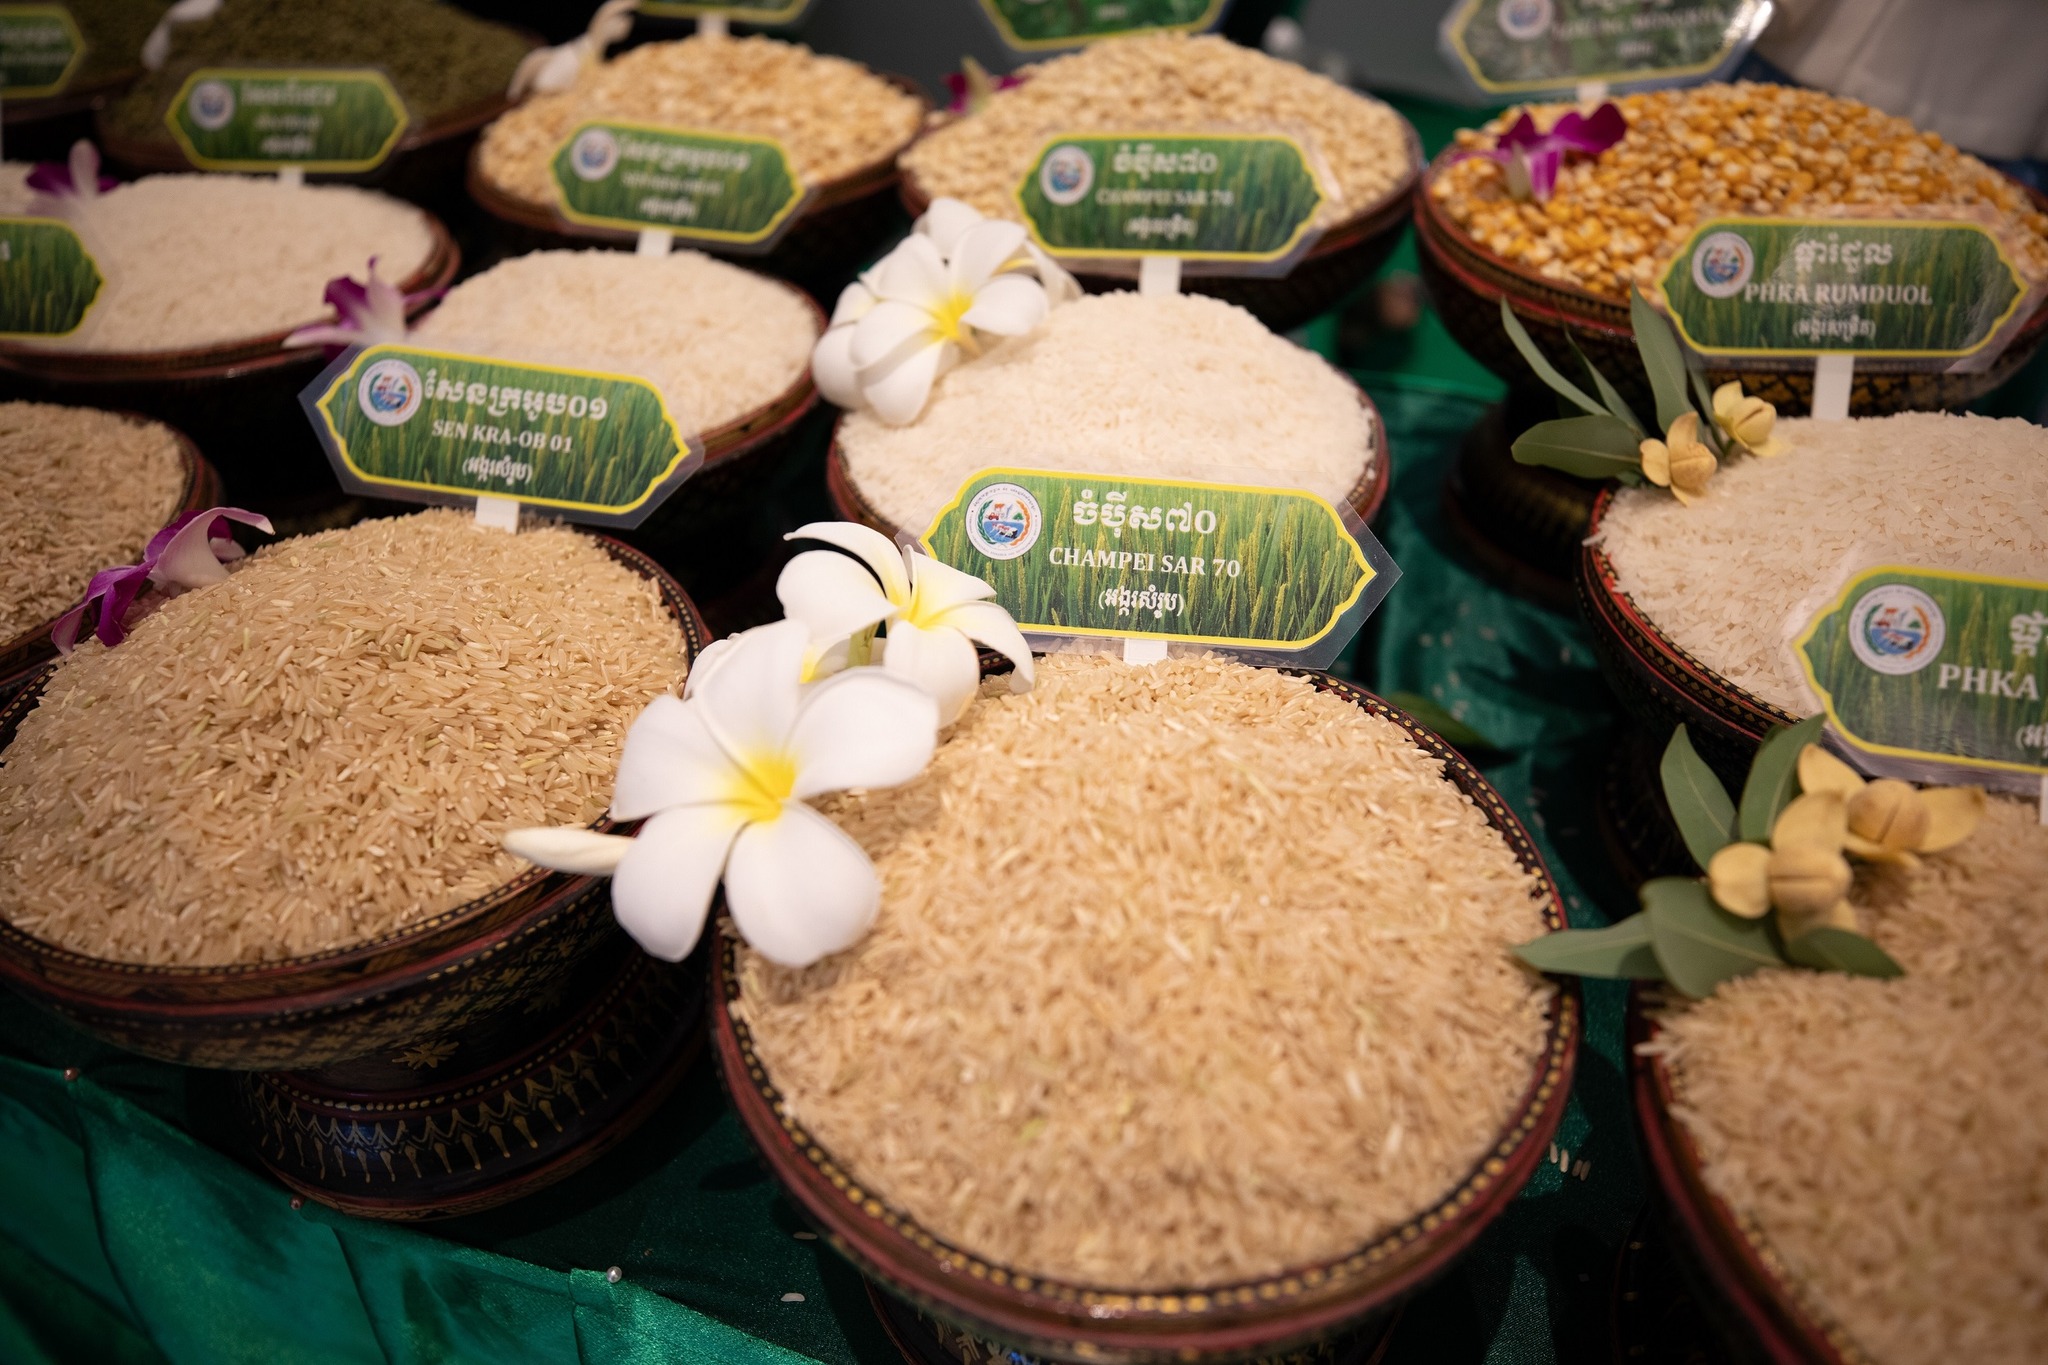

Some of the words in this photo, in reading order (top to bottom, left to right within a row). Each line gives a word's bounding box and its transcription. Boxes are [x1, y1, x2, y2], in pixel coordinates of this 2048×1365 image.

[1743, 283, 1809, 304] PHKA
[1815, 283, 1933, 306] RUMDUOL
[432, 419, 468, 439] SEN
[472, 426, 546, 449] KRA-OB
[550, 435, 573, 453] 01
[1049, 546, 1155, 574] CHAMPEI
[1161, 554, 1206, 577] SAR
[1212, 557, 1241, 578] 70
[1937, 663, 2041, 702] PHKA
